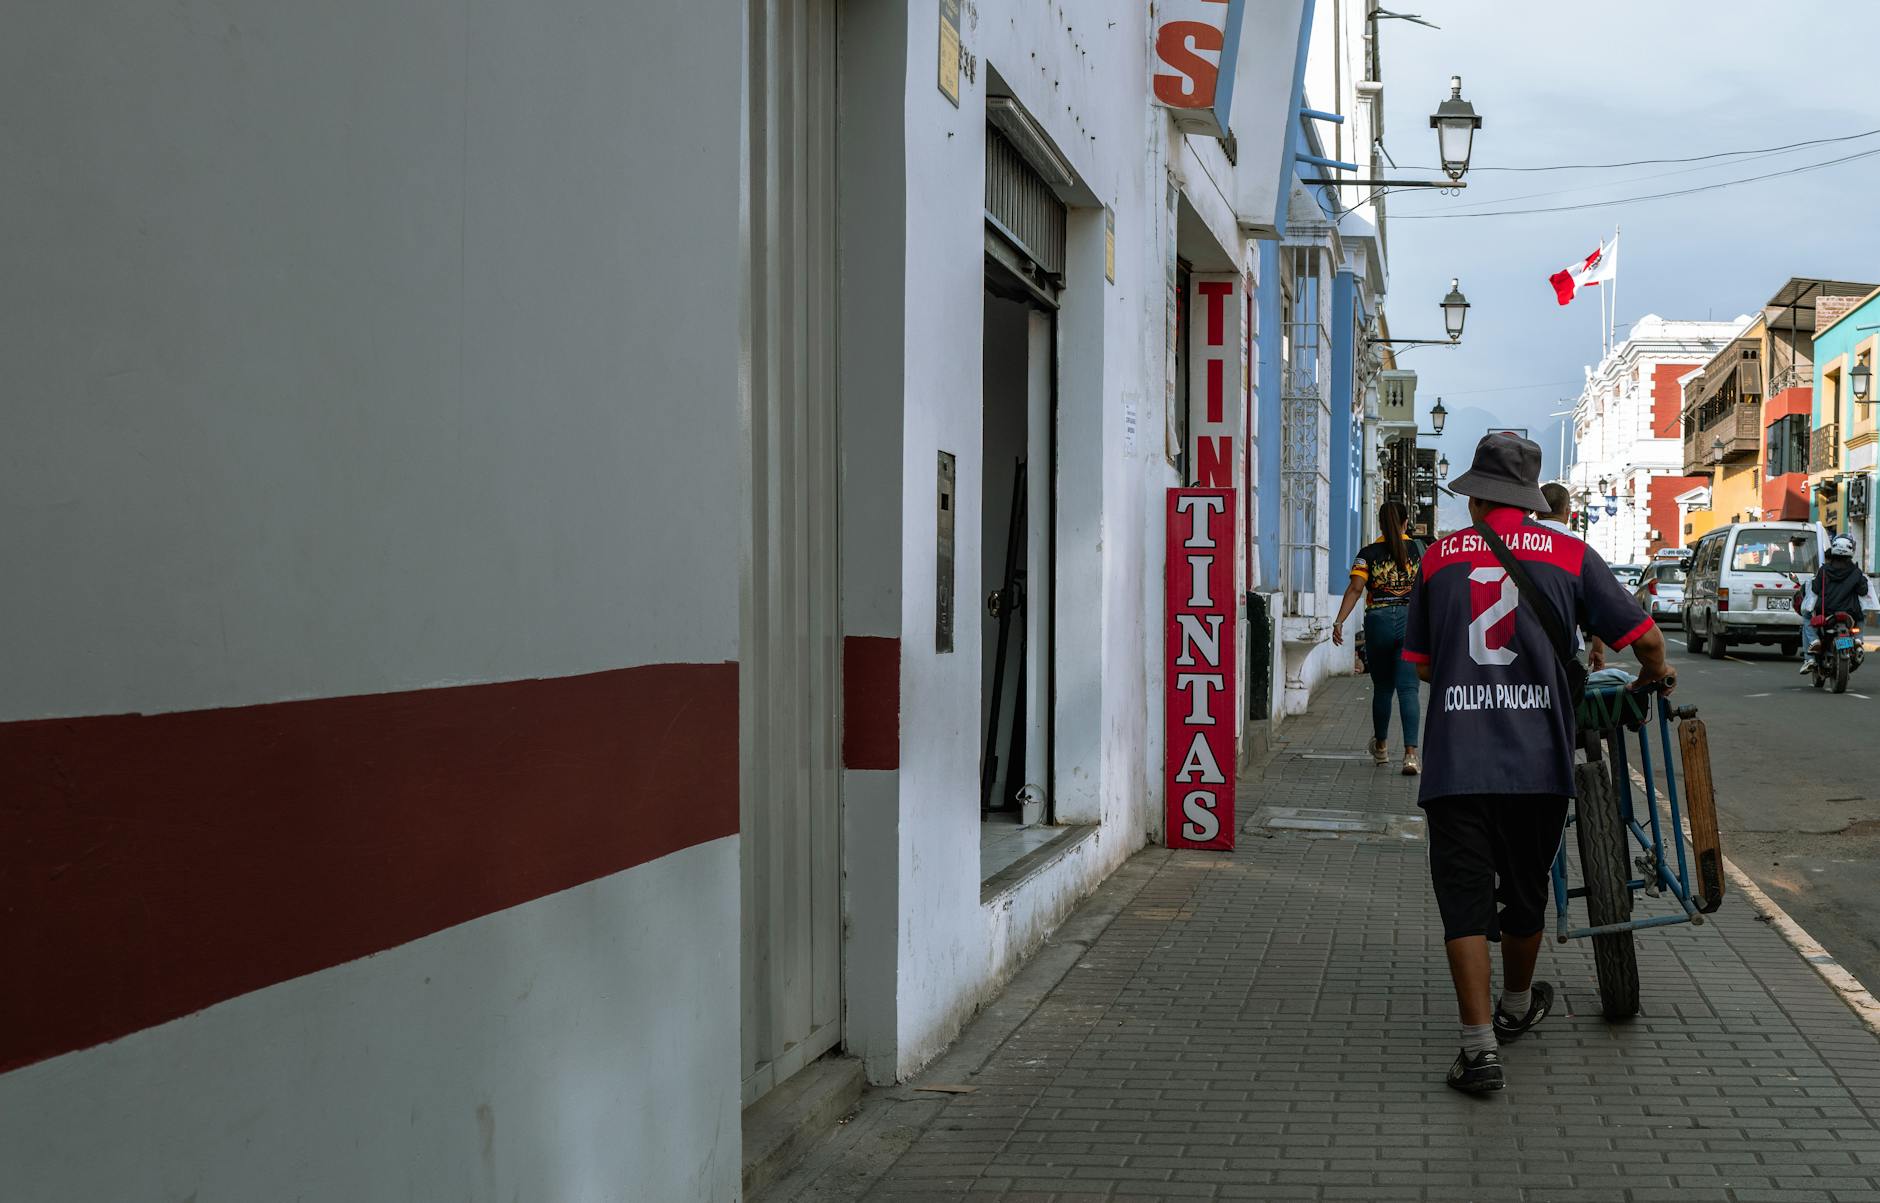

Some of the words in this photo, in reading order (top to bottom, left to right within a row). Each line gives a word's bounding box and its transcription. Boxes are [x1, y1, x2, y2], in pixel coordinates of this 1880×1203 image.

[1441, 536, 1459, 557] F.C.
[1462, 532, 1519, 552] ESTRLA
[1522, 532, 1553, 553] ROJA
[1467, 566, 1519, 665] 2
[1175, 495, 1226, 843] TINTAS
[1496, 683, 1551, 710] PAUCARA
